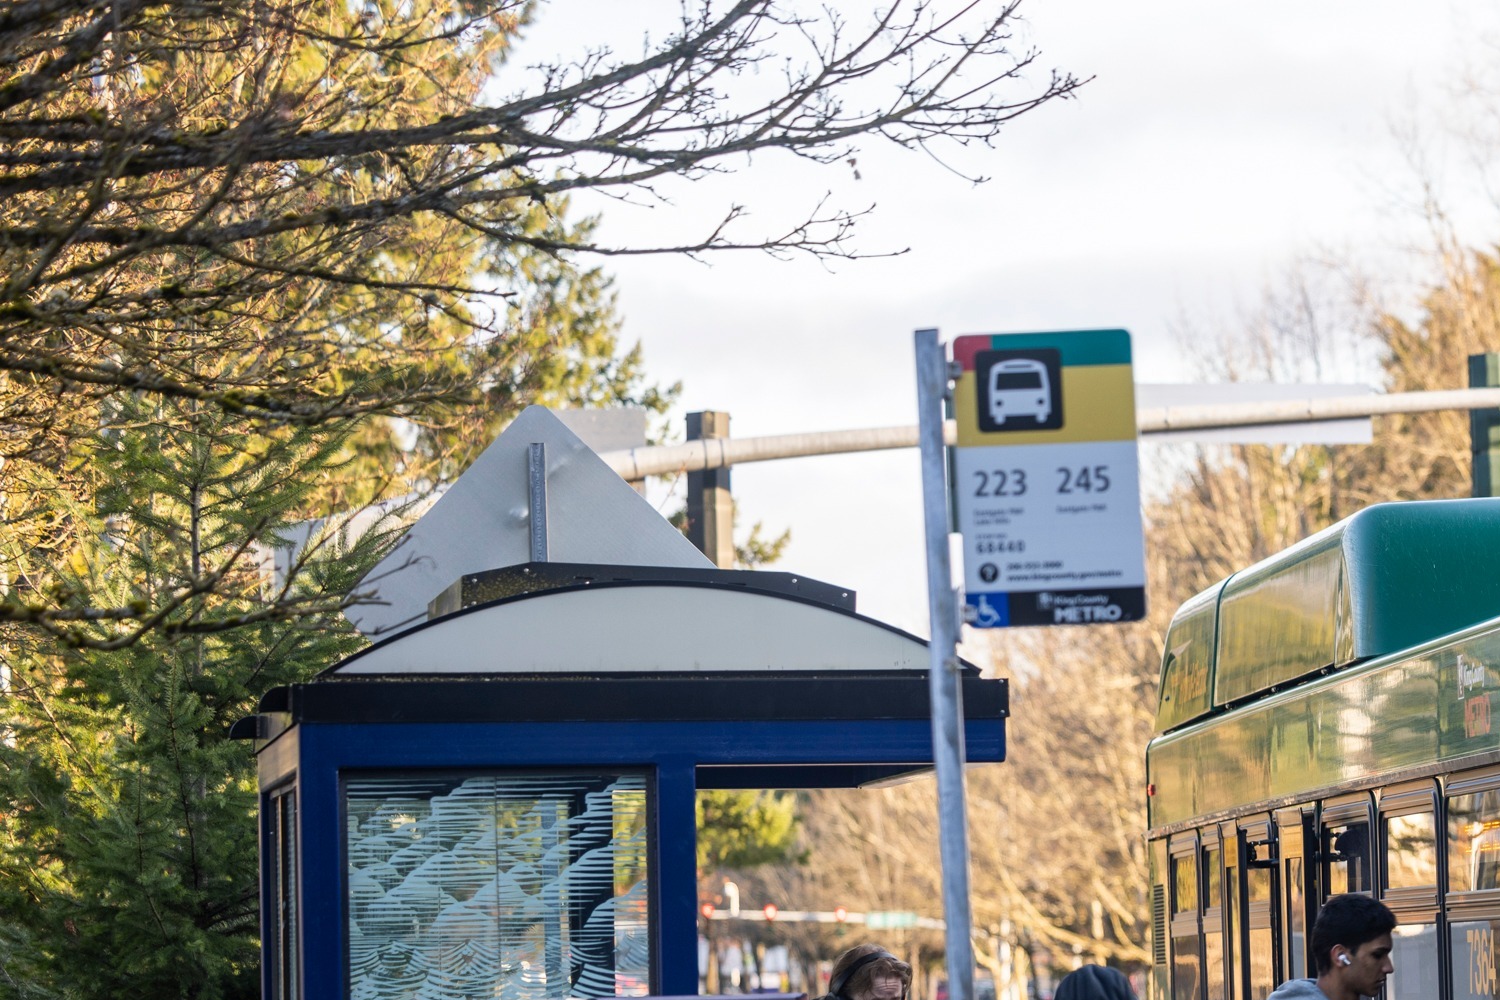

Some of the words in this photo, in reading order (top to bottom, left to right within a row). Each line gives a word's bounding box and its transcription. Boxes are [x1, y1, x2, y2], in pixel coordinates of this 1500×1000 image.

[974, 468, 1028, 497] 223
[1056, 465, 1110, 494] 245
[1054, 604, 1122, 622] METRO
[1464, 691, 1491, 739] METRO
[1466, 928, 1496, 996] 7364
